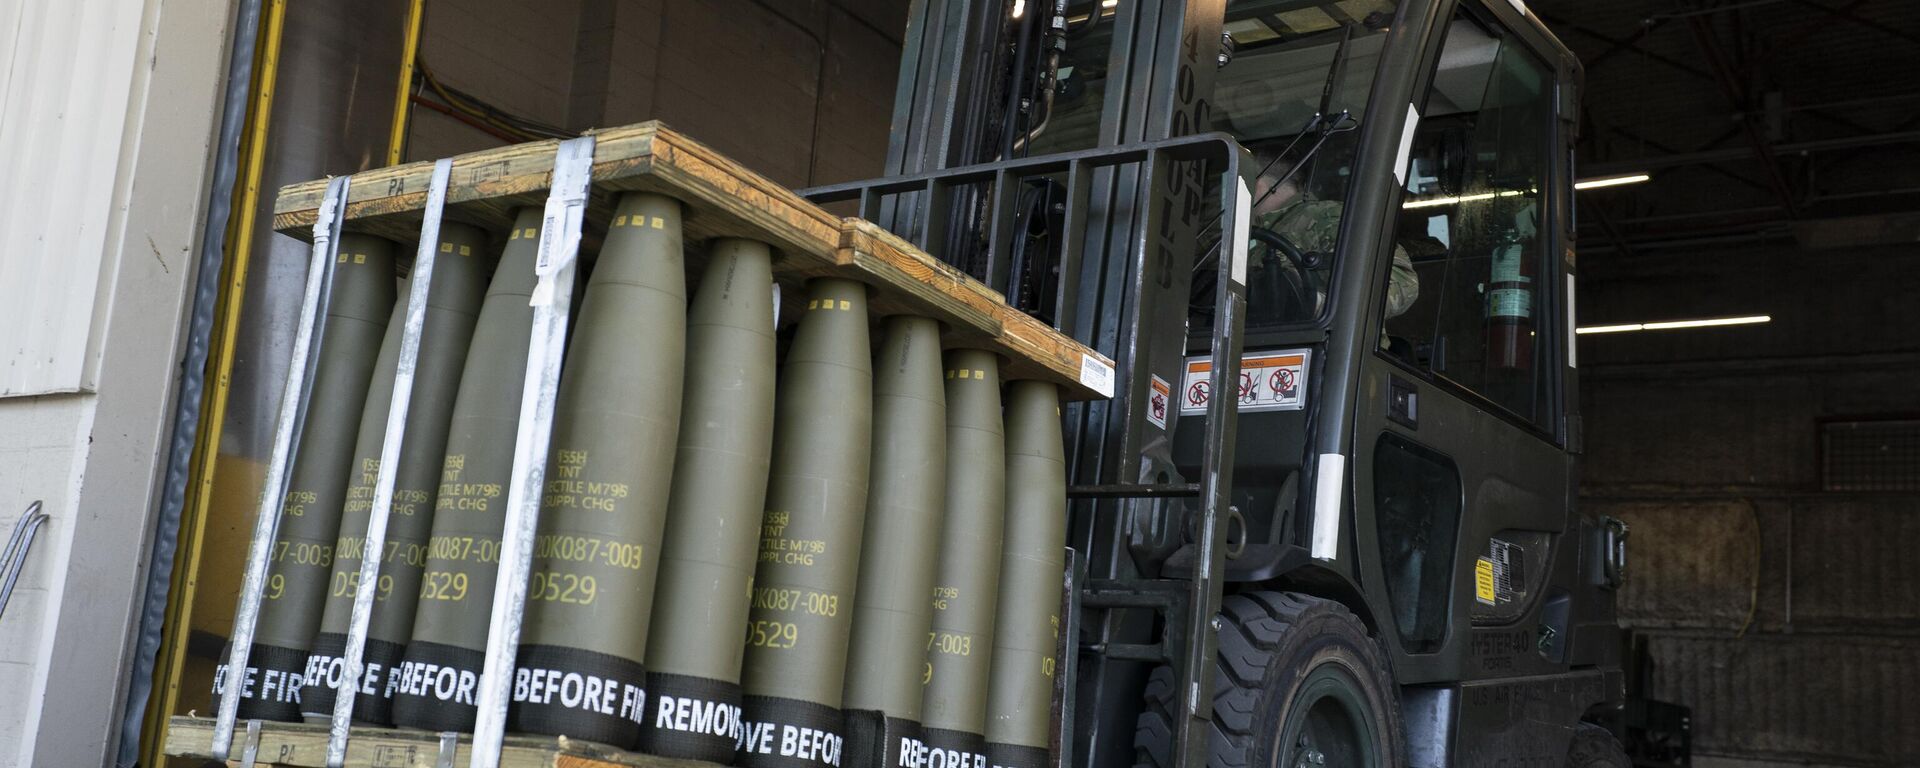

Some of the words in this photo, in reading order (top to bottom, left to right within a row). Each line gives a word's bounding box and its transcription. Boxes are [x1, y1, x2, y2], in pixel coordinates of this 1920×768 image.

[388, 177, 405, 196] PA
[558, 465, 583, 478] TNT
[457, 496, 488, 512] CHG
[582, 495, 616, 513] CHG
[785, 552, 814, 566] CHG
[333, 571, 395, 601] D59
[531, 571, 597, 605] D529
[302, 655, 381, 696] BEFOE
[400, 661, 484, 706] BEFOR
[513, 667, 618, 716] BEFORE
